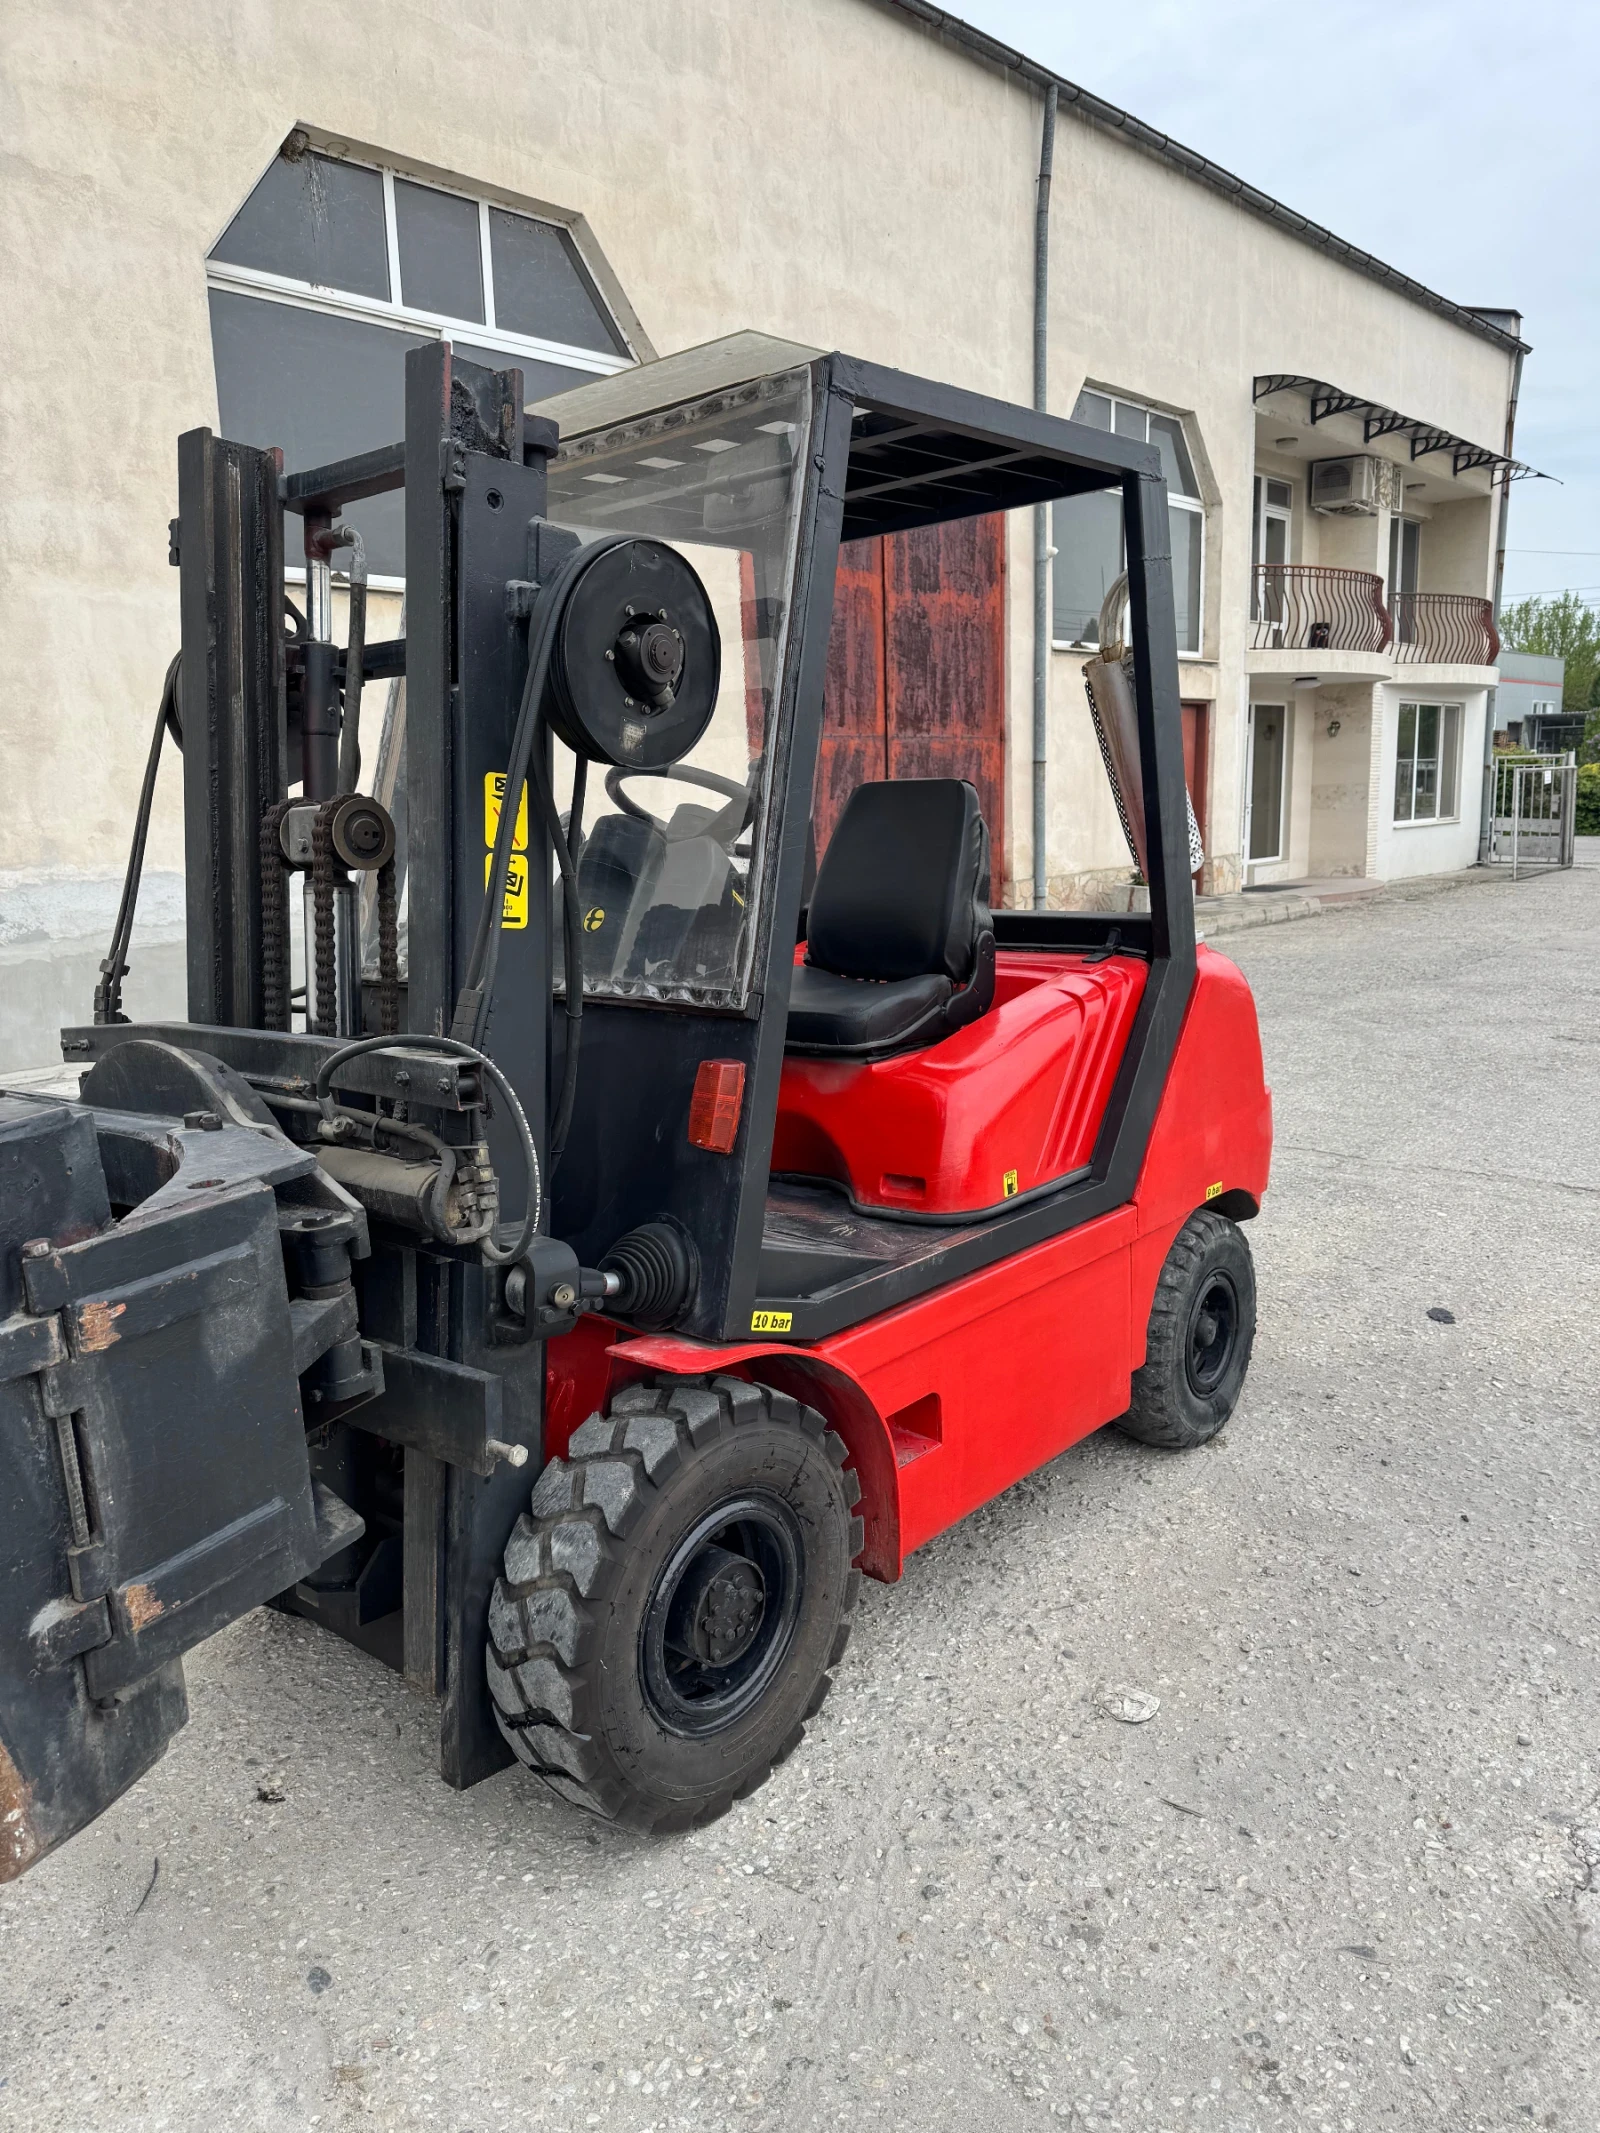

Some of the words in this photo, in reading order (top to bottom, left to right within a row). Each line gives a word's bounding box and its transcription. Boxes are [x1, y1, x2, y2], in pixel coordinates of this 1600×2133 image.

[1208, 1188, 1211, 1197] 9
[1212, 1186, 1221, 1195] bar
[754, 1314, 768, 1328] 10
[770, 1315, 790, 1329] bar
